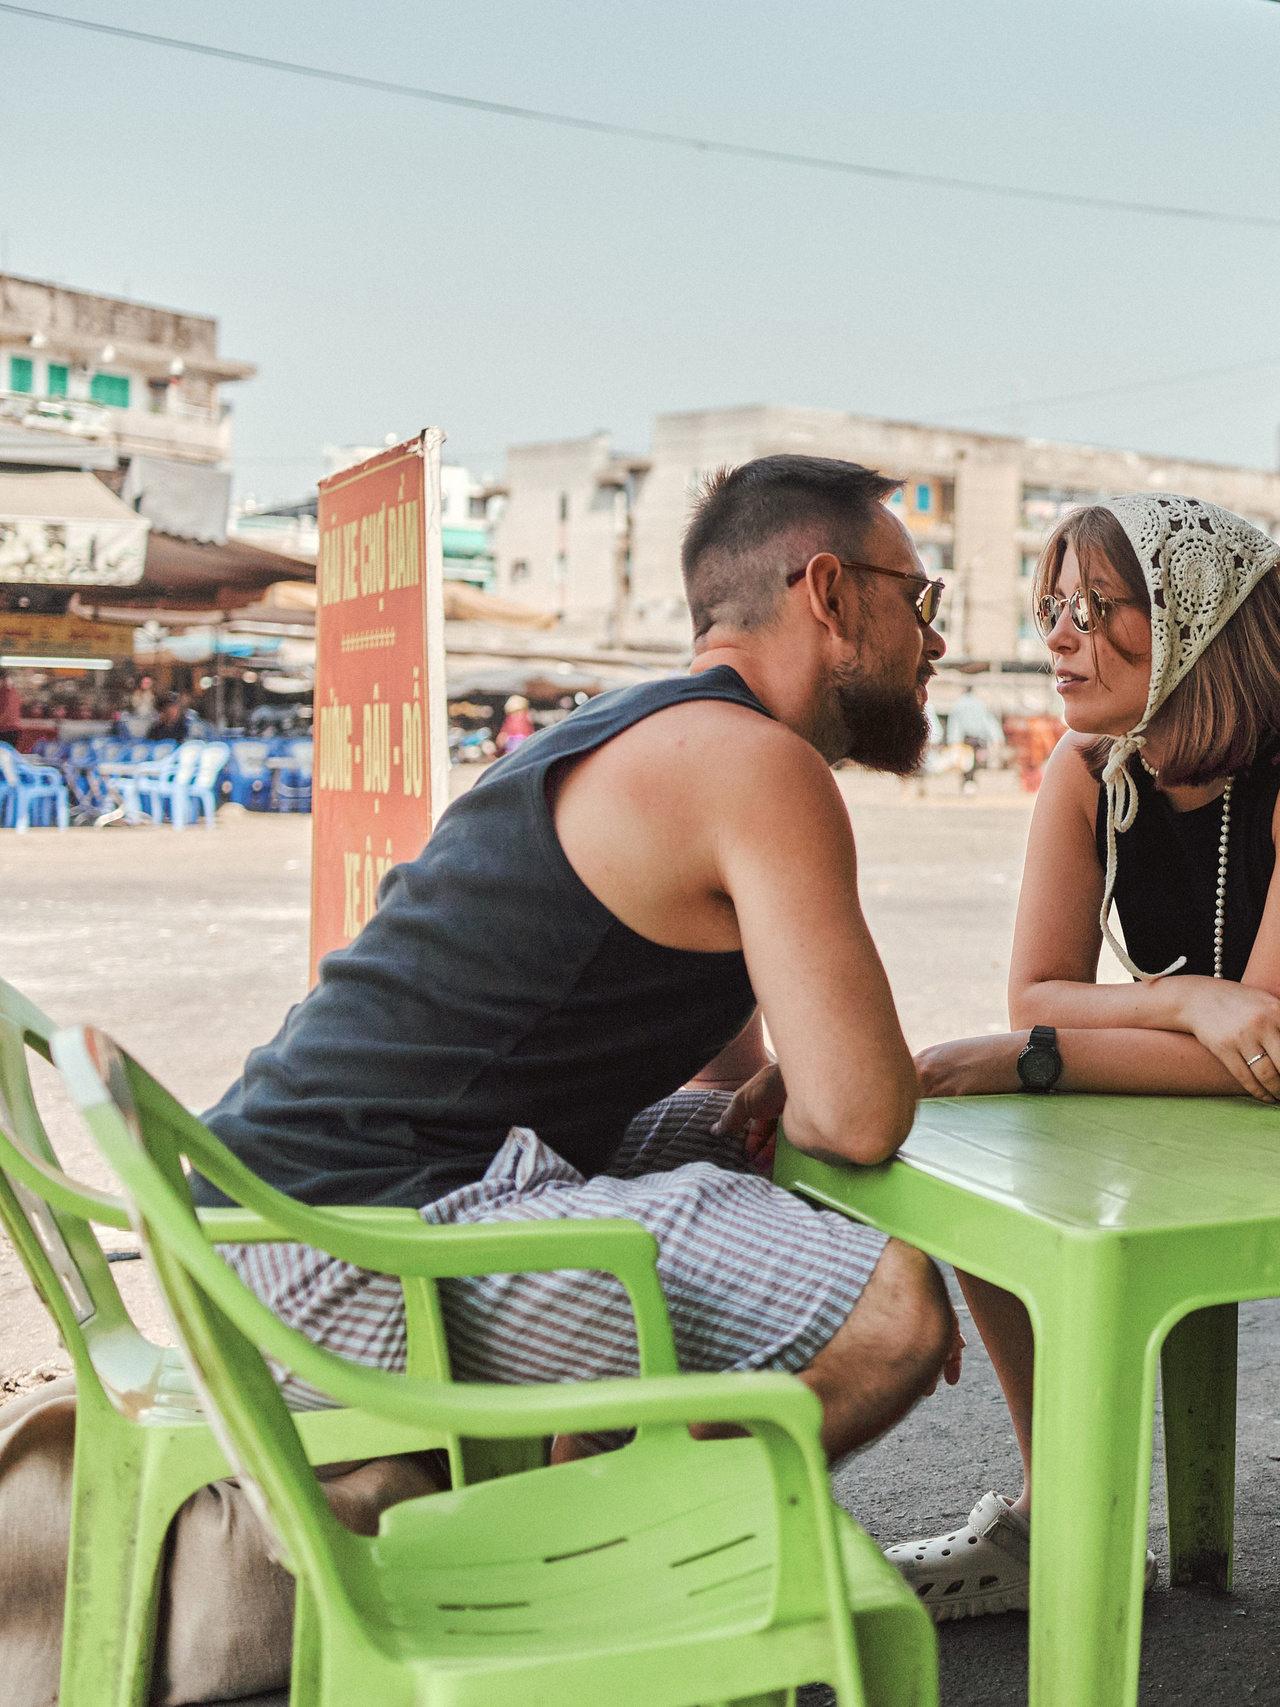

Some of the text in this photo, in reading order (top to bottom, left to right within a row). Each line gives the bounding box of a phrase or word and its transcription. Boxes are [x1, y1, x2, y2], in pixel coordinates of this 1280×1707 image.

[342, 519, 359, 601] XE
[360, 501, 386, 612] CHỢ
[343, 851, 361, 938] XE
